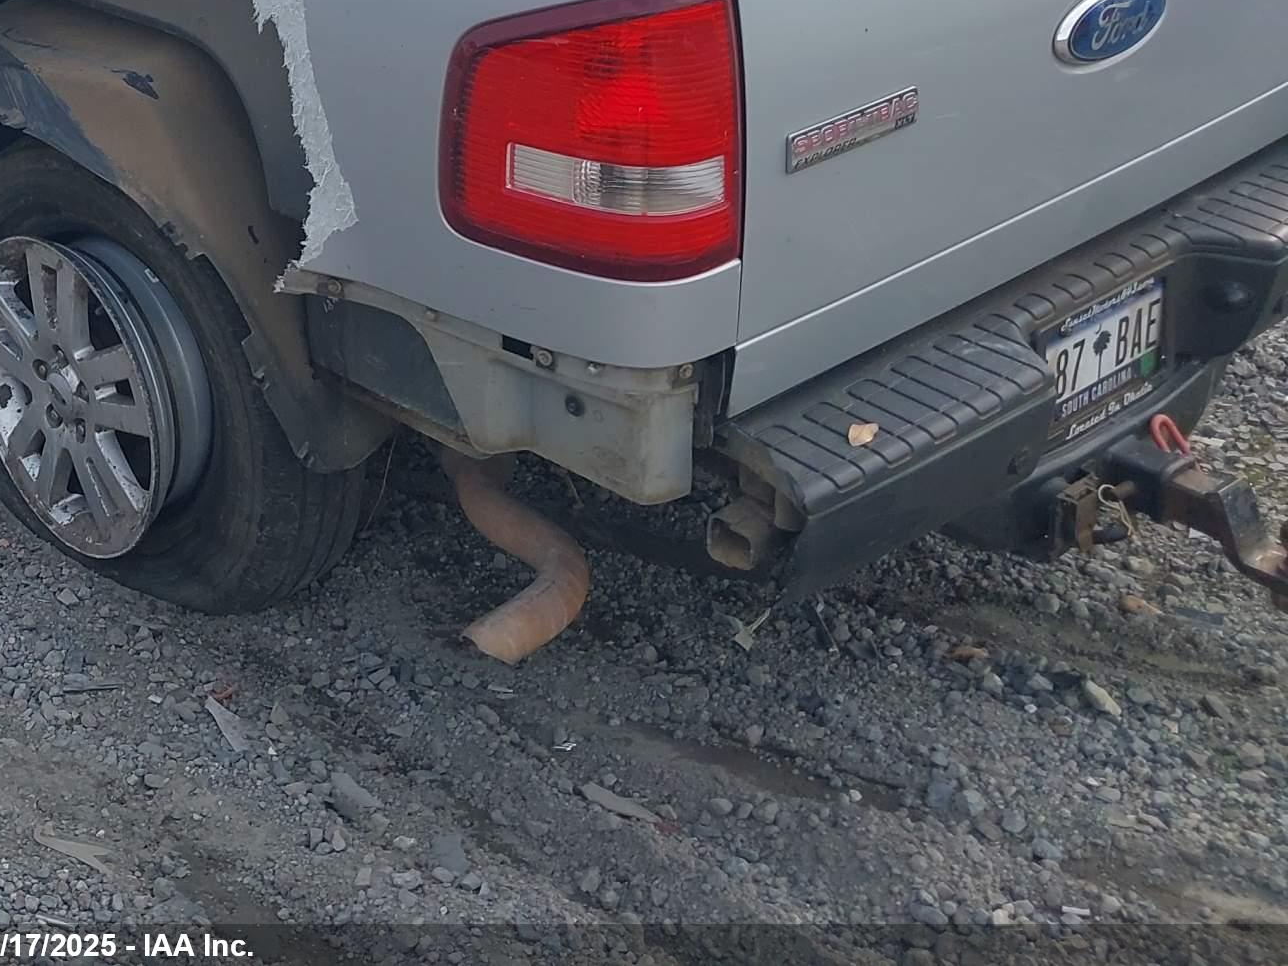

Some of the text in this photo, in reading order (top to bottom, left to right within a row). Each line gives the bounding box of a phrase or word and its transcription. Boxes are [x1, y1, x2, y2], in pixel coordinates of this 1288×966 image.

[1090, 0, 1154, 51] Ford
[792, 91, 918, 156] SPORT TRAC
[793, 137, 857, 170] EXPLORER
[1114, 297, 1161, 367] BAE
[1061, 366, 1132, 418] SOUTH CAROLINA
[1065, 409, 1107, 440] Located
